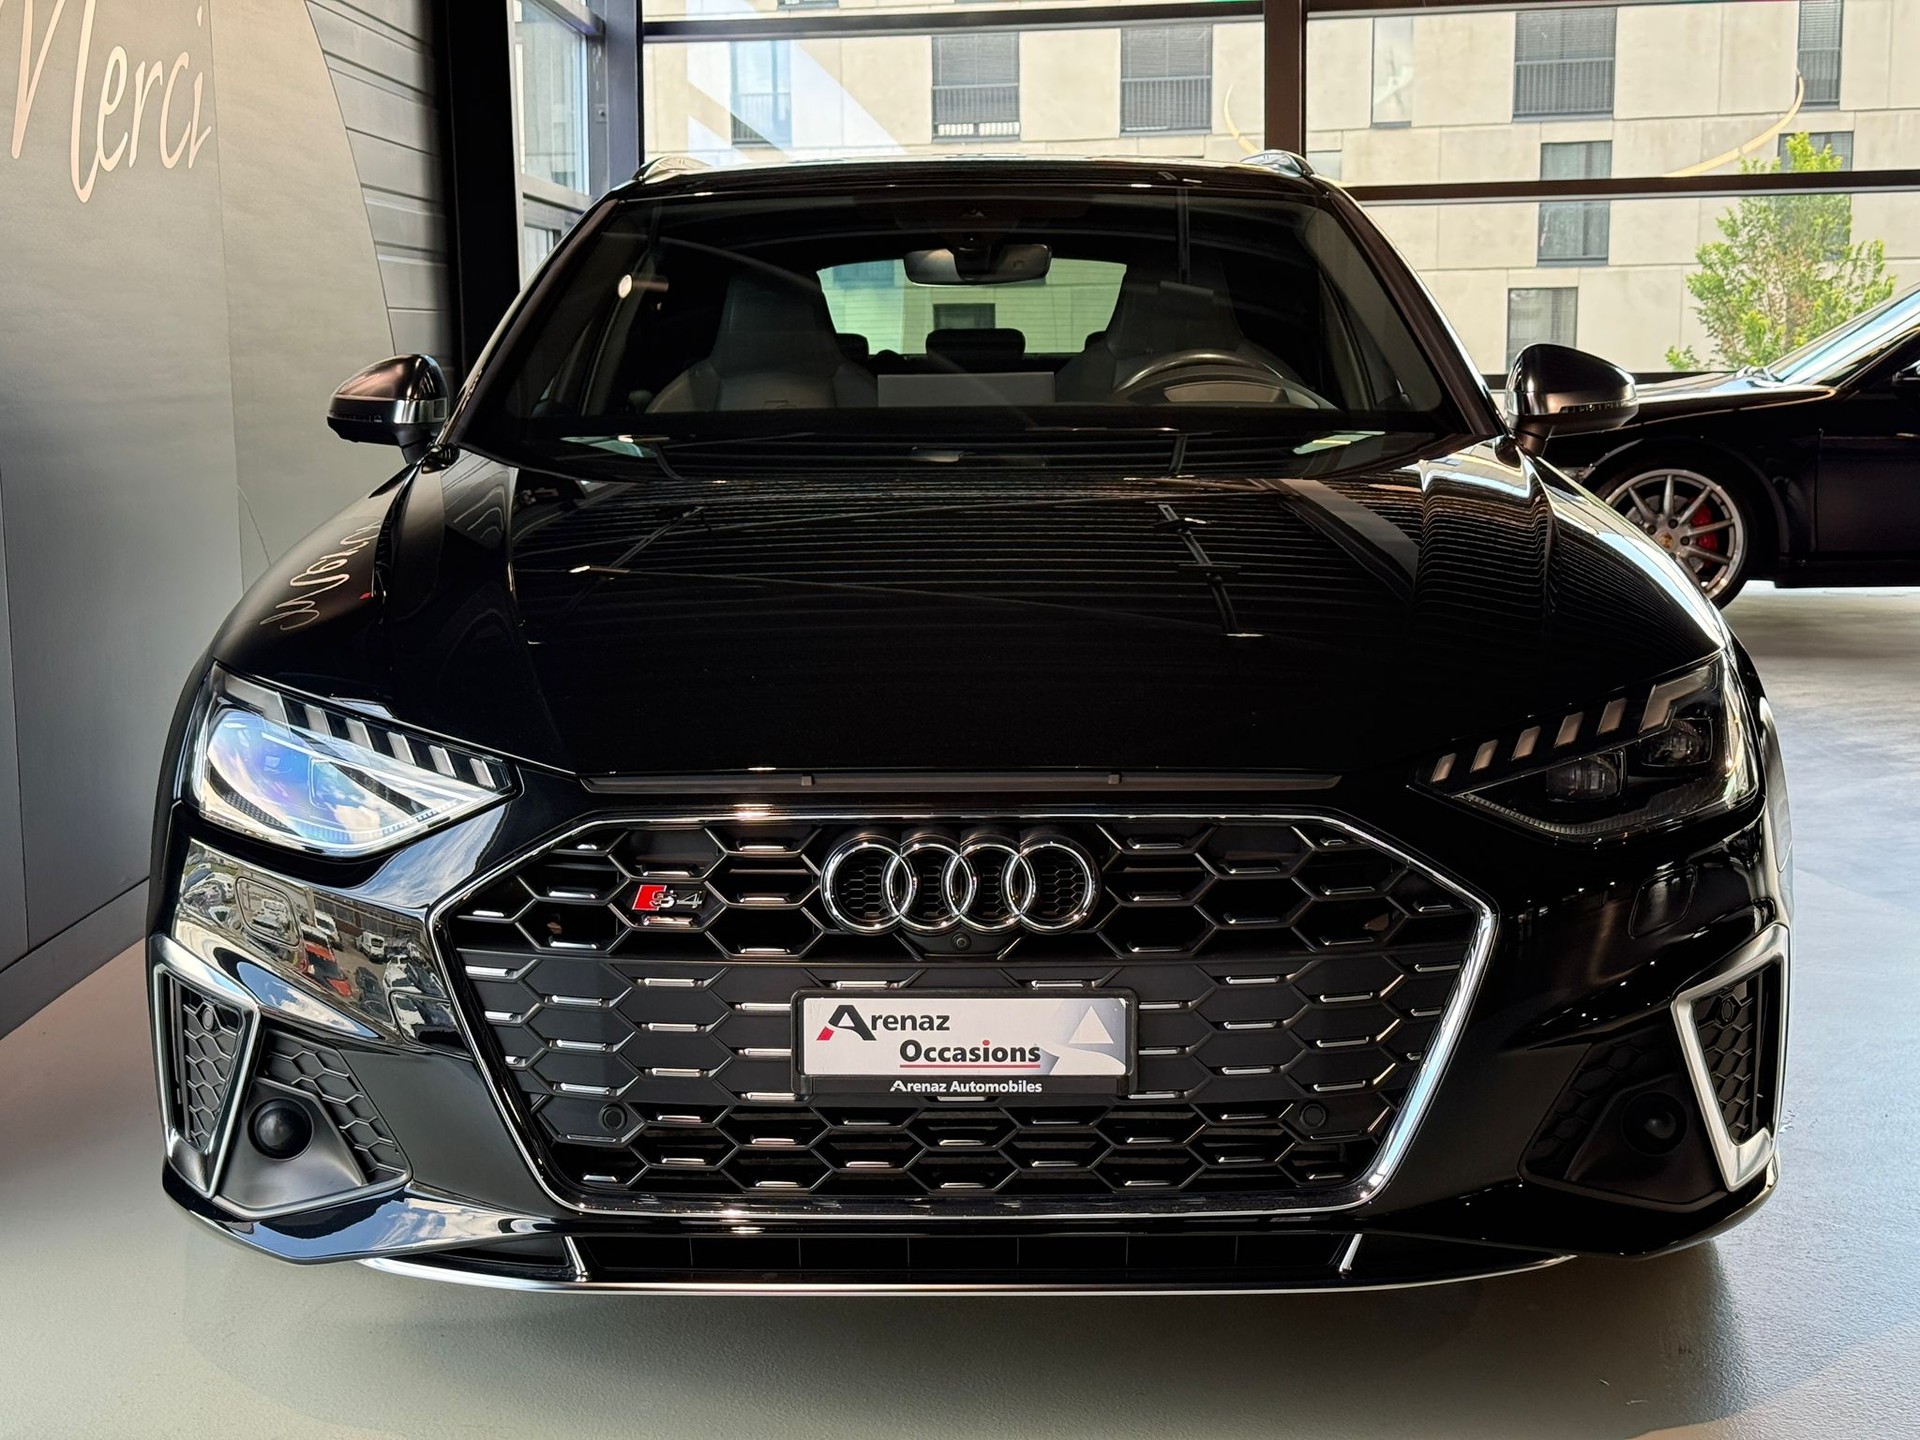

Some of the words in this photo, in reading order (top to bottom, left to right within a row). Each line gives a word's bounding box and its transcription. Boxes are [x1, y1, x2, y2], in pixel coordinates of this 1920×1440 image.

[648, 888, 703, 909] S4
[816, 1005, 950, 1041] Arenaz
[899, 1039, 1041, 1063] Occasions
[890, 1080, 947, 1093] Arenaz
[950, 1080, 1043, 1093] Automobiles
